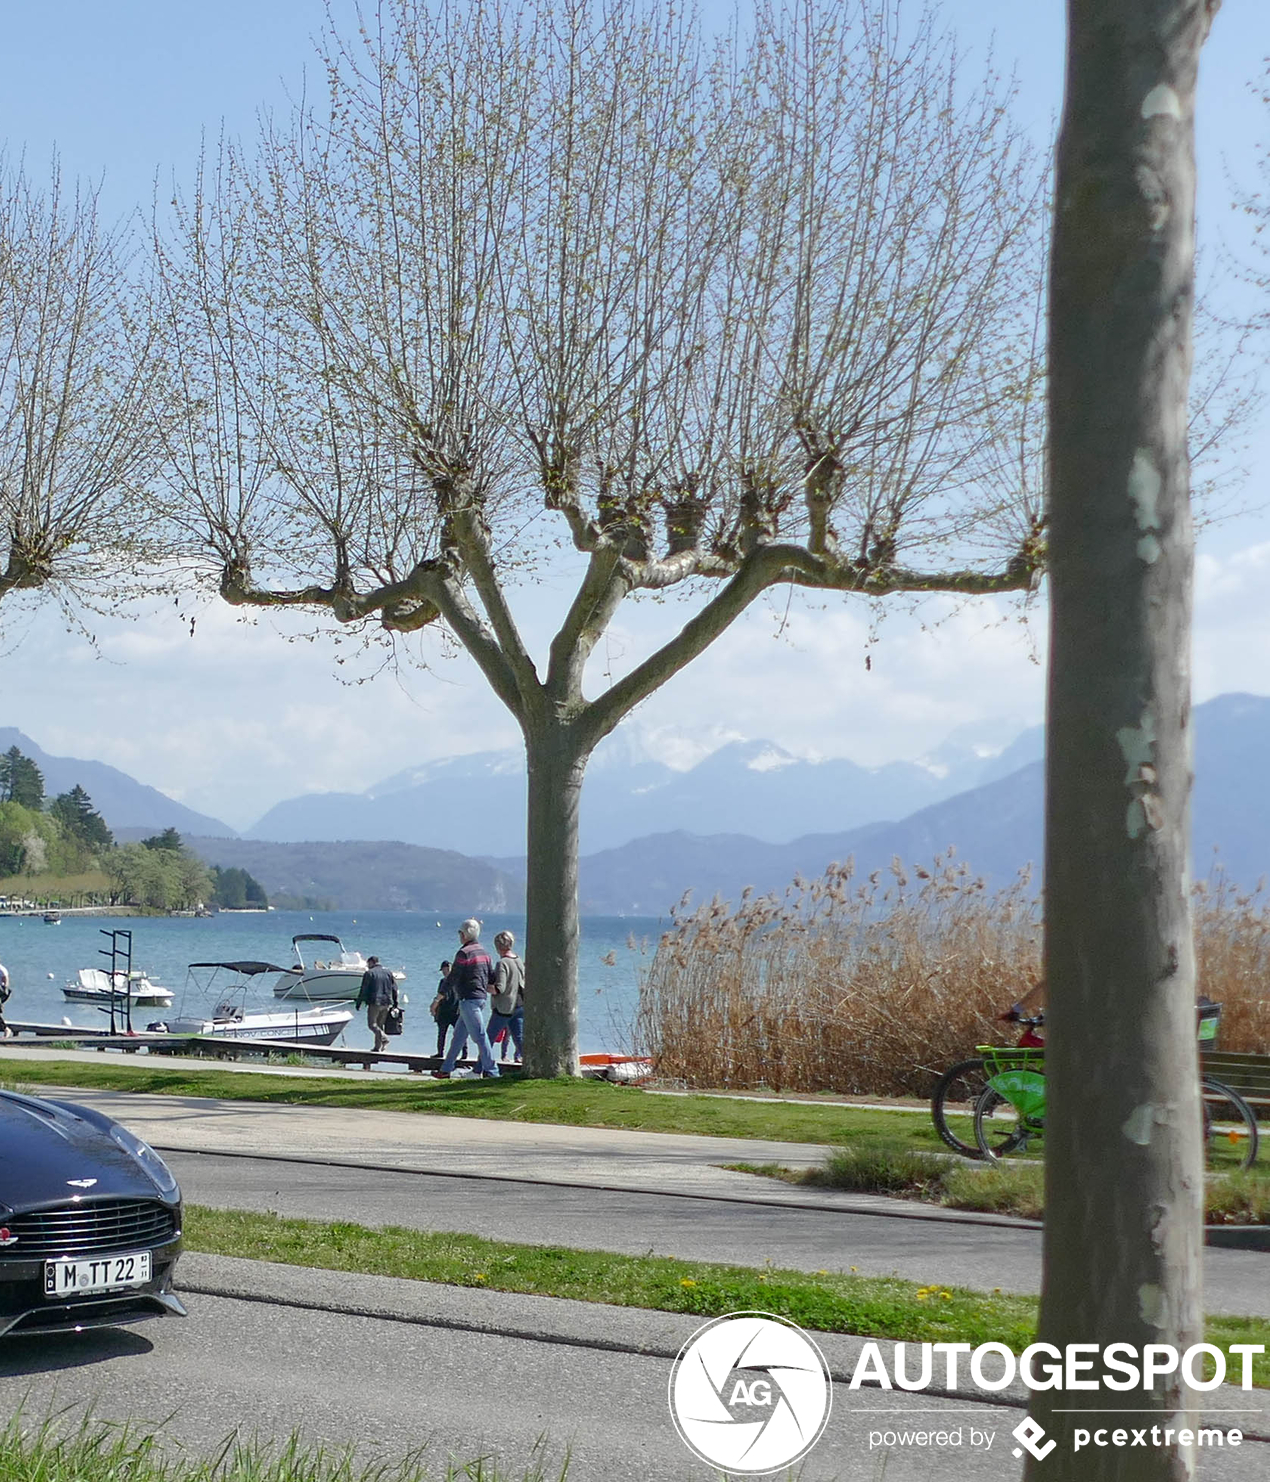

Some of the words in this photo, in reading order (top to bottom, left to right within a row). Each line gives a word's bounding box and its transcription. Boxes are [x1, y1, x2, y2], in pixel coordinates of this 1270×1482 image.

[64, 1264, 77, 1288] M
[89, 1260, 112, 1285] TT
[115, 1257, 135, 1282] 22
